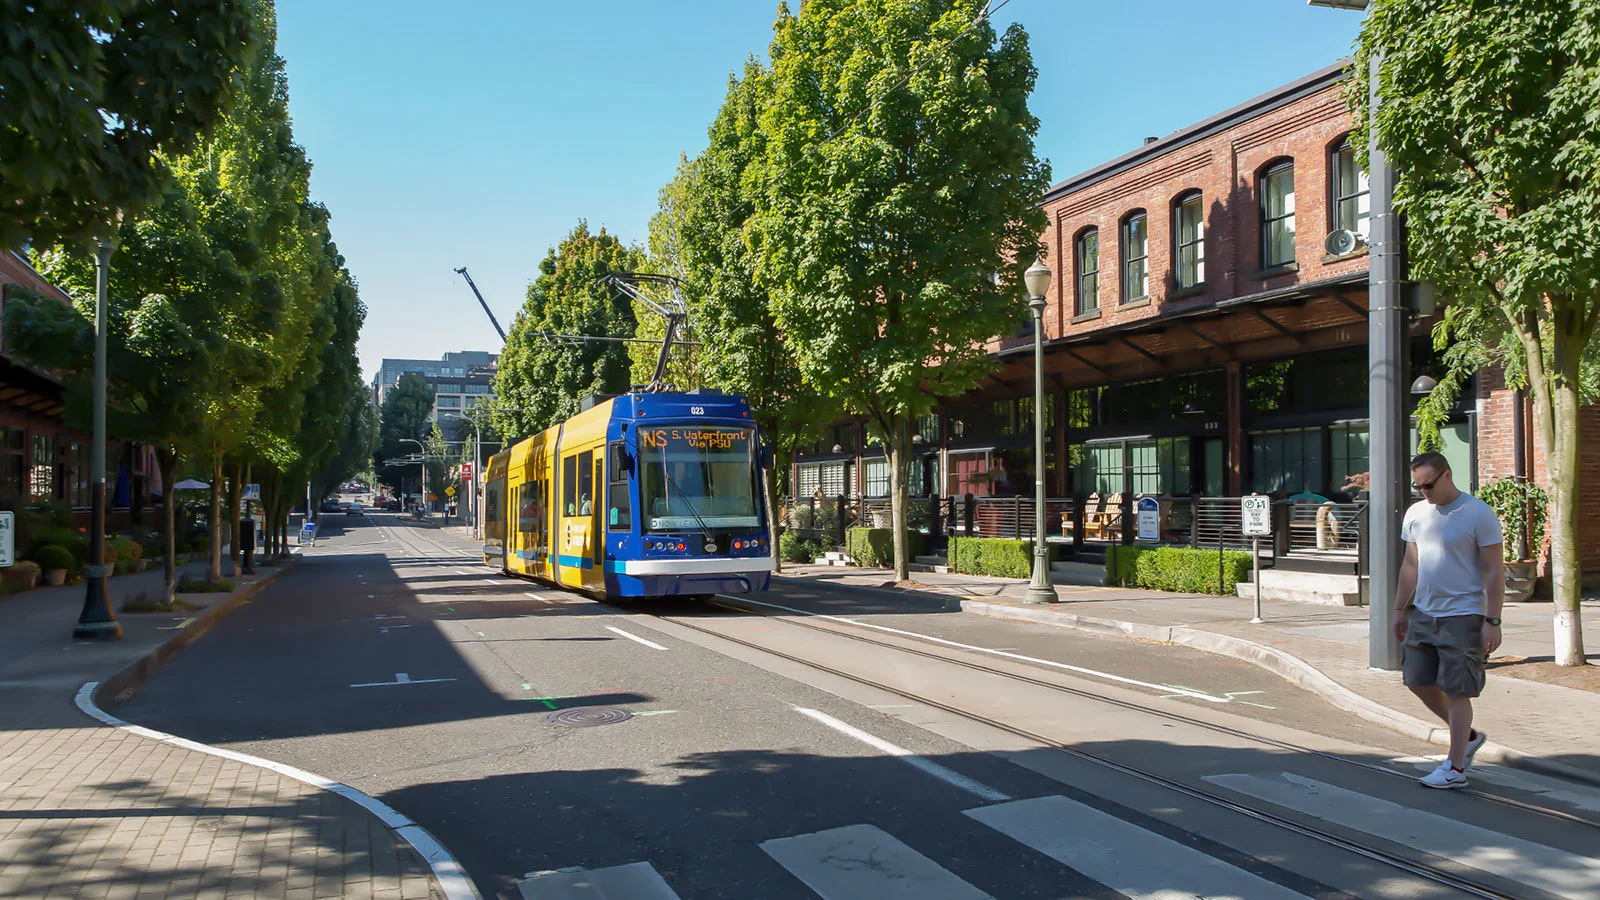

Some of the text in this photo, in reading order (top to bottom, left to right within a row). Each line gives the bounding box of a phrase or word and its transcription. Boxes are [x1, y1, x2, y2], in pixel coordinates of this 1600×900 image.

[690, 406, 704, 414] 023
[643, 430, 668, 448] NS
[672, 430, 681, 440] S.
[688, 439, 731, 448] Via PSU
